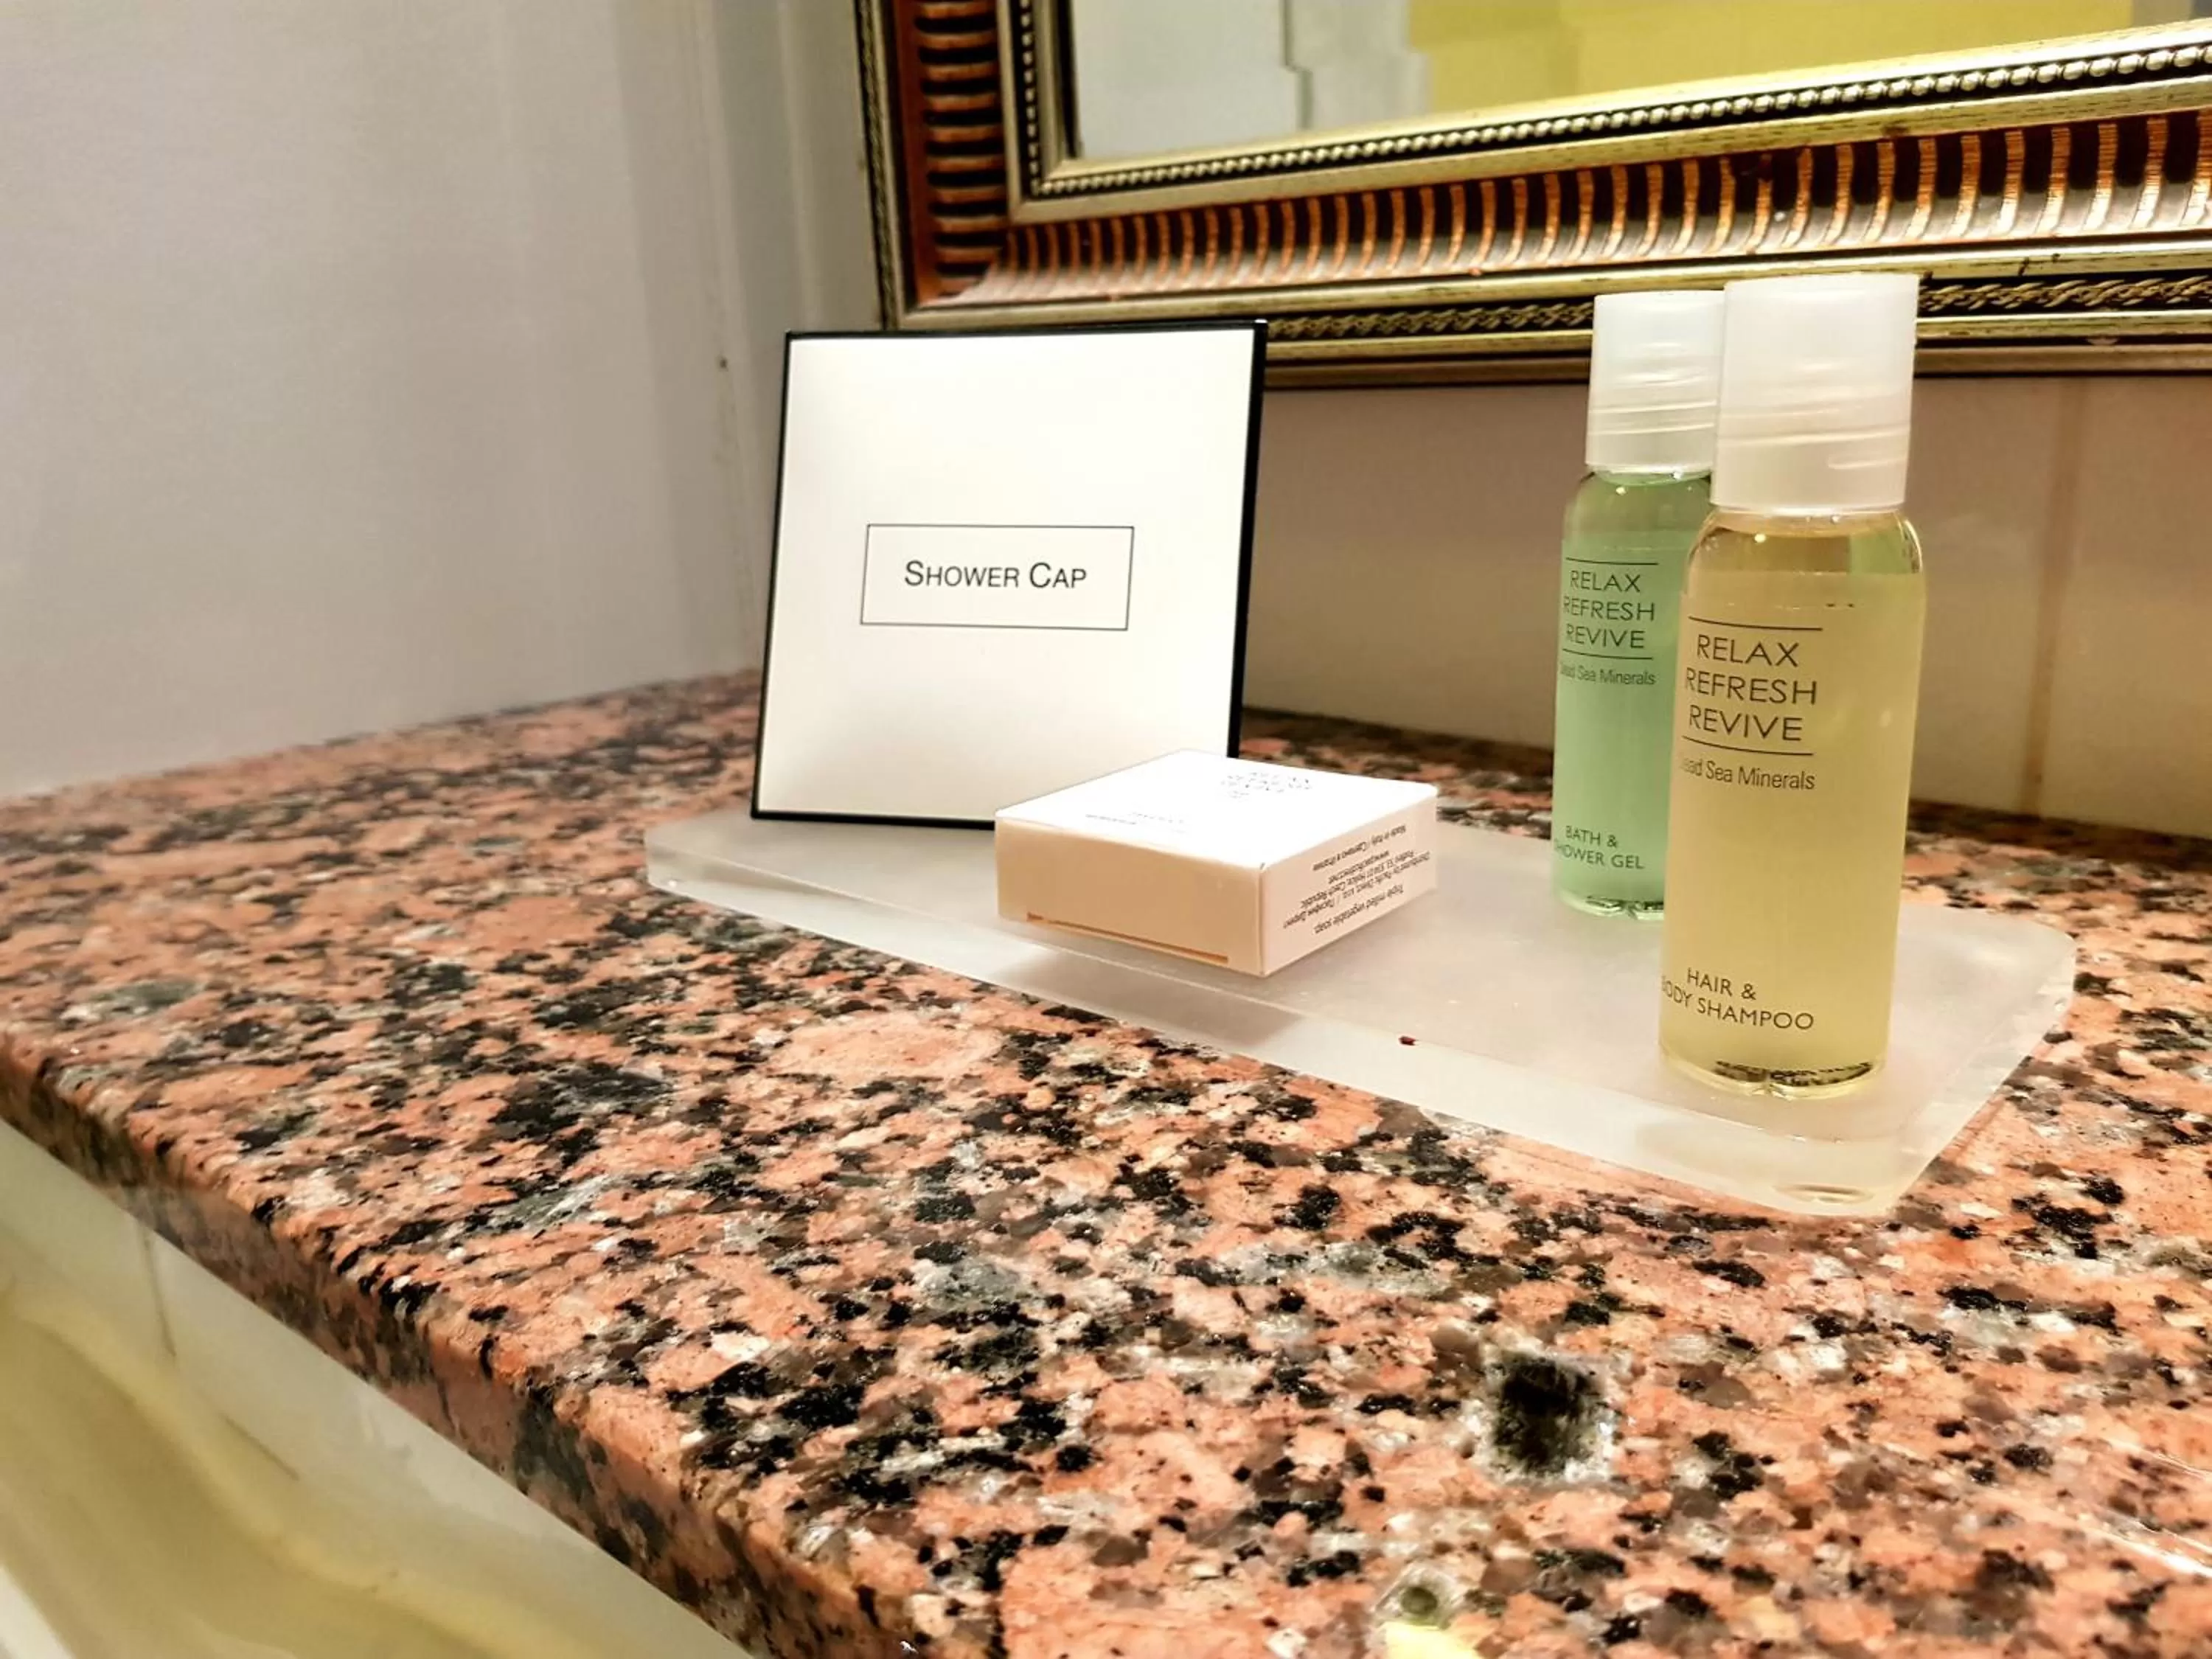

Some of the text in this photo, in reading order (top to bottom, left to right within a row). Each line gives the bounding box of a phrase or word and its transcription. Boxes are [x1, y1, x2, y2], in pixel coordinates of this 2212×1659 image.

[904, 560, 1087, 588] SHOWER CAP
[1571, 571, 1641, 592] RELAX
[1563, 596, 1655, 621] REFRESH
[1567, 624, 1645, 648] REVIVE
[1697, 634, 1799, 667] RELAX
[1577, 665, 1596, 681] Sea
[1599, 669, 1657, 685] Minerals
[1686, 667, 1818, 704] REFRESH
[1689, 704, 1803, 741] REVIVE
[1705, 760, 1733, 782] Sea
[1738, 766, 1815, 790] Minerals
[1565, 825, 1618, 848] BATH &
[1611, 854, 1645, 869] GEL
[1687, 967, 1756, 1000] HAIR &
[1697, 998, 1814, 1030] SHAMPOO
